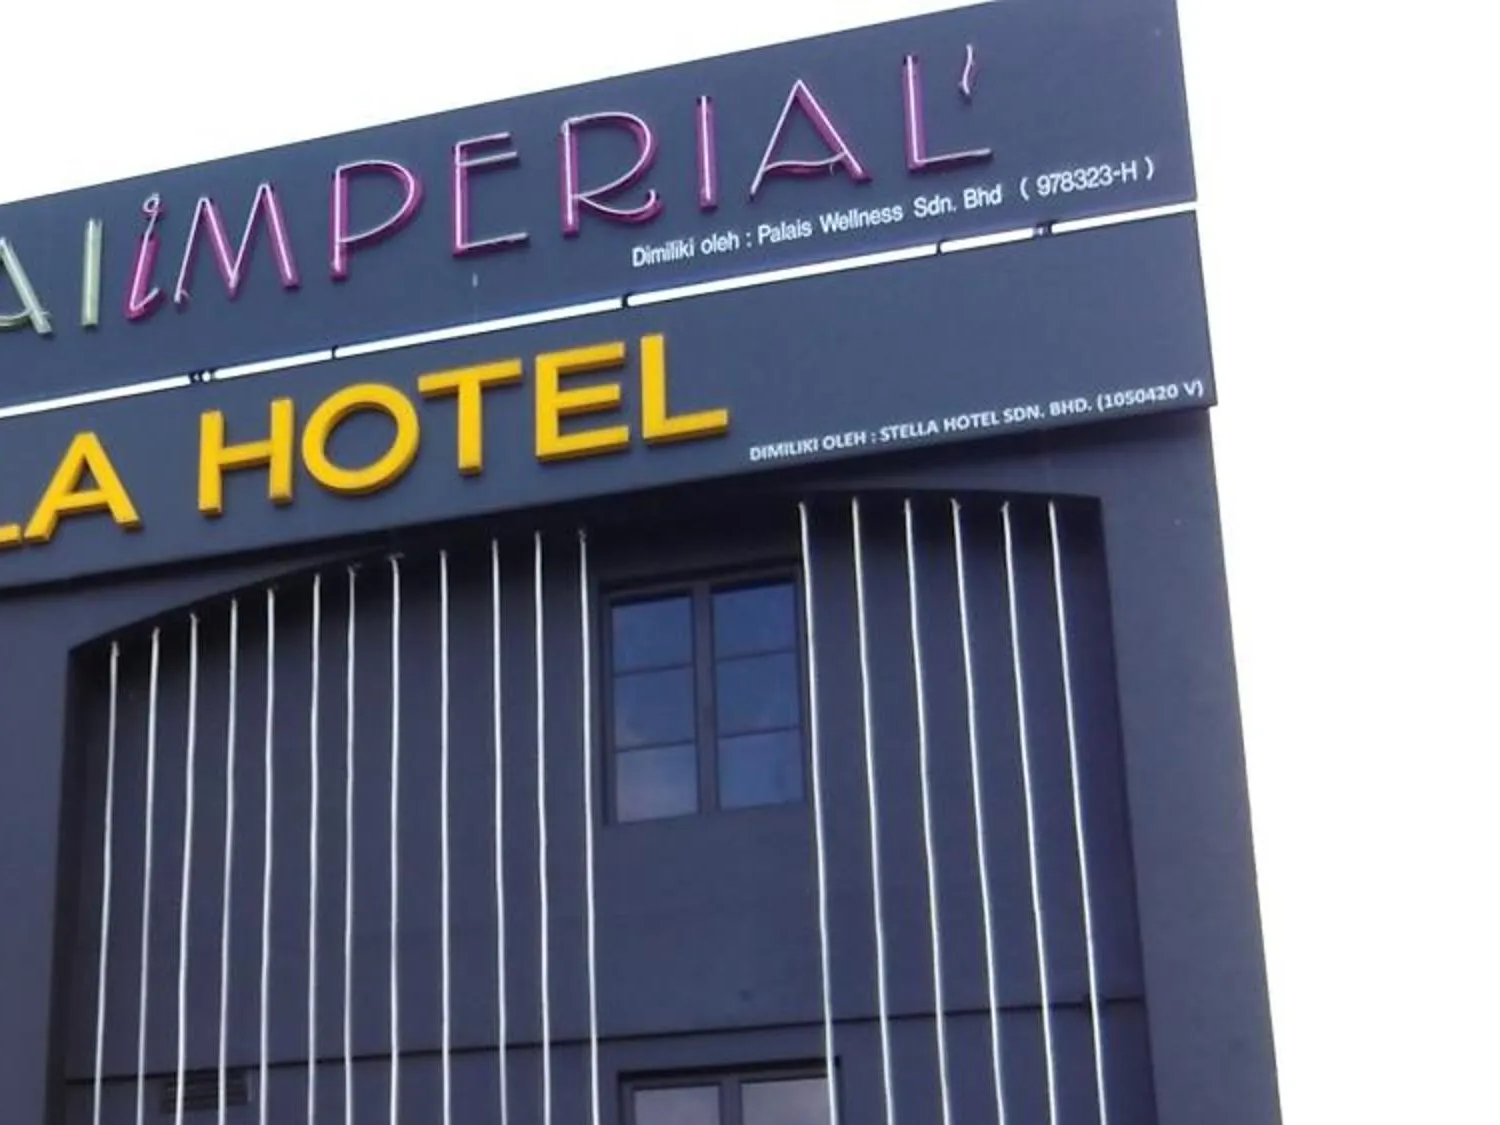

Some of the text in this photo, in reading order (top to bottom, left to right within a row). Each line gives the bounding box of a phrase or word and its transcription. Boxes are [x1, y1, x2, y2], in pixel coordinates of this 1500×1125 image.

[632, 240, 695, 267] Dimiliki
[701, 231, 740, 255] oleh
[758, 218, 813, 245] Palais
[820, 204, 904, 233] Wellness
[913, 194, 957, 218] Sdn.
[963, 184, 1003, 209] Bhd
[197, 333, 729, 517] HOTEL
[749, 437, 819, 462] DIMILIKI
[822, 430, 867, 452] OLEH
[879, 419, 940, 443] STELLA
[943, 409, 1000, 433] HOTEL
[1003, 405, 1046, 424] SDN.
[1049, 397, 1093, 417] BHD.
[1097, 384, 1179, 413] (1050420
[1182, 379, 1204, 398] V)
